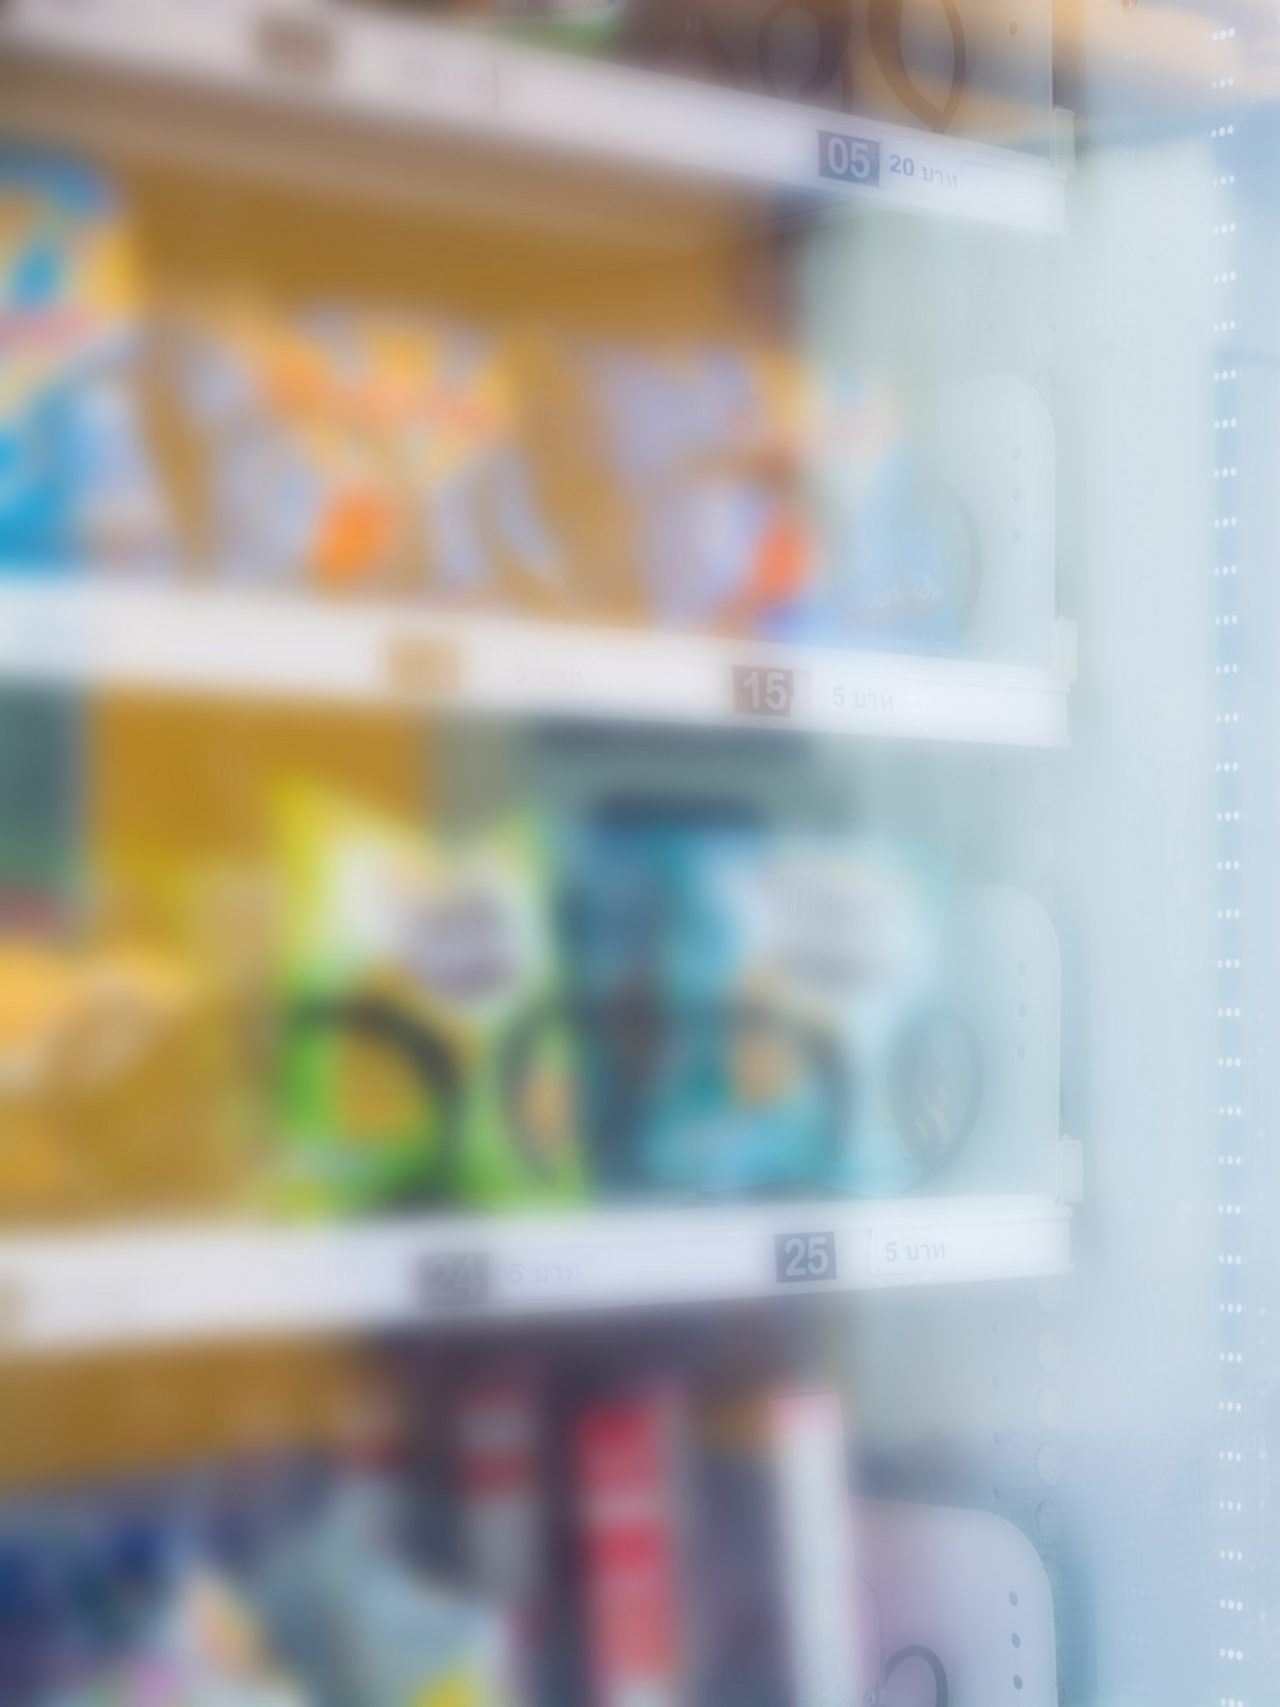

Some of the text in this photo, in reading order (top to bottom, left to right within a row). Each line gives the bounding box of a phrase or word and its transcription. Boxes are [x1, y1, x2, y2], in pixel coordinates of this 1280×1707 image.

[828, 137, 957, 188] 05 20 บาท
[743, 671, 787, 711] 15
[832, 686, 845, 707] 5
[509, 1263, 523, 1283] 5
[784, 1237, 946, 1276] 25 5 บาท
